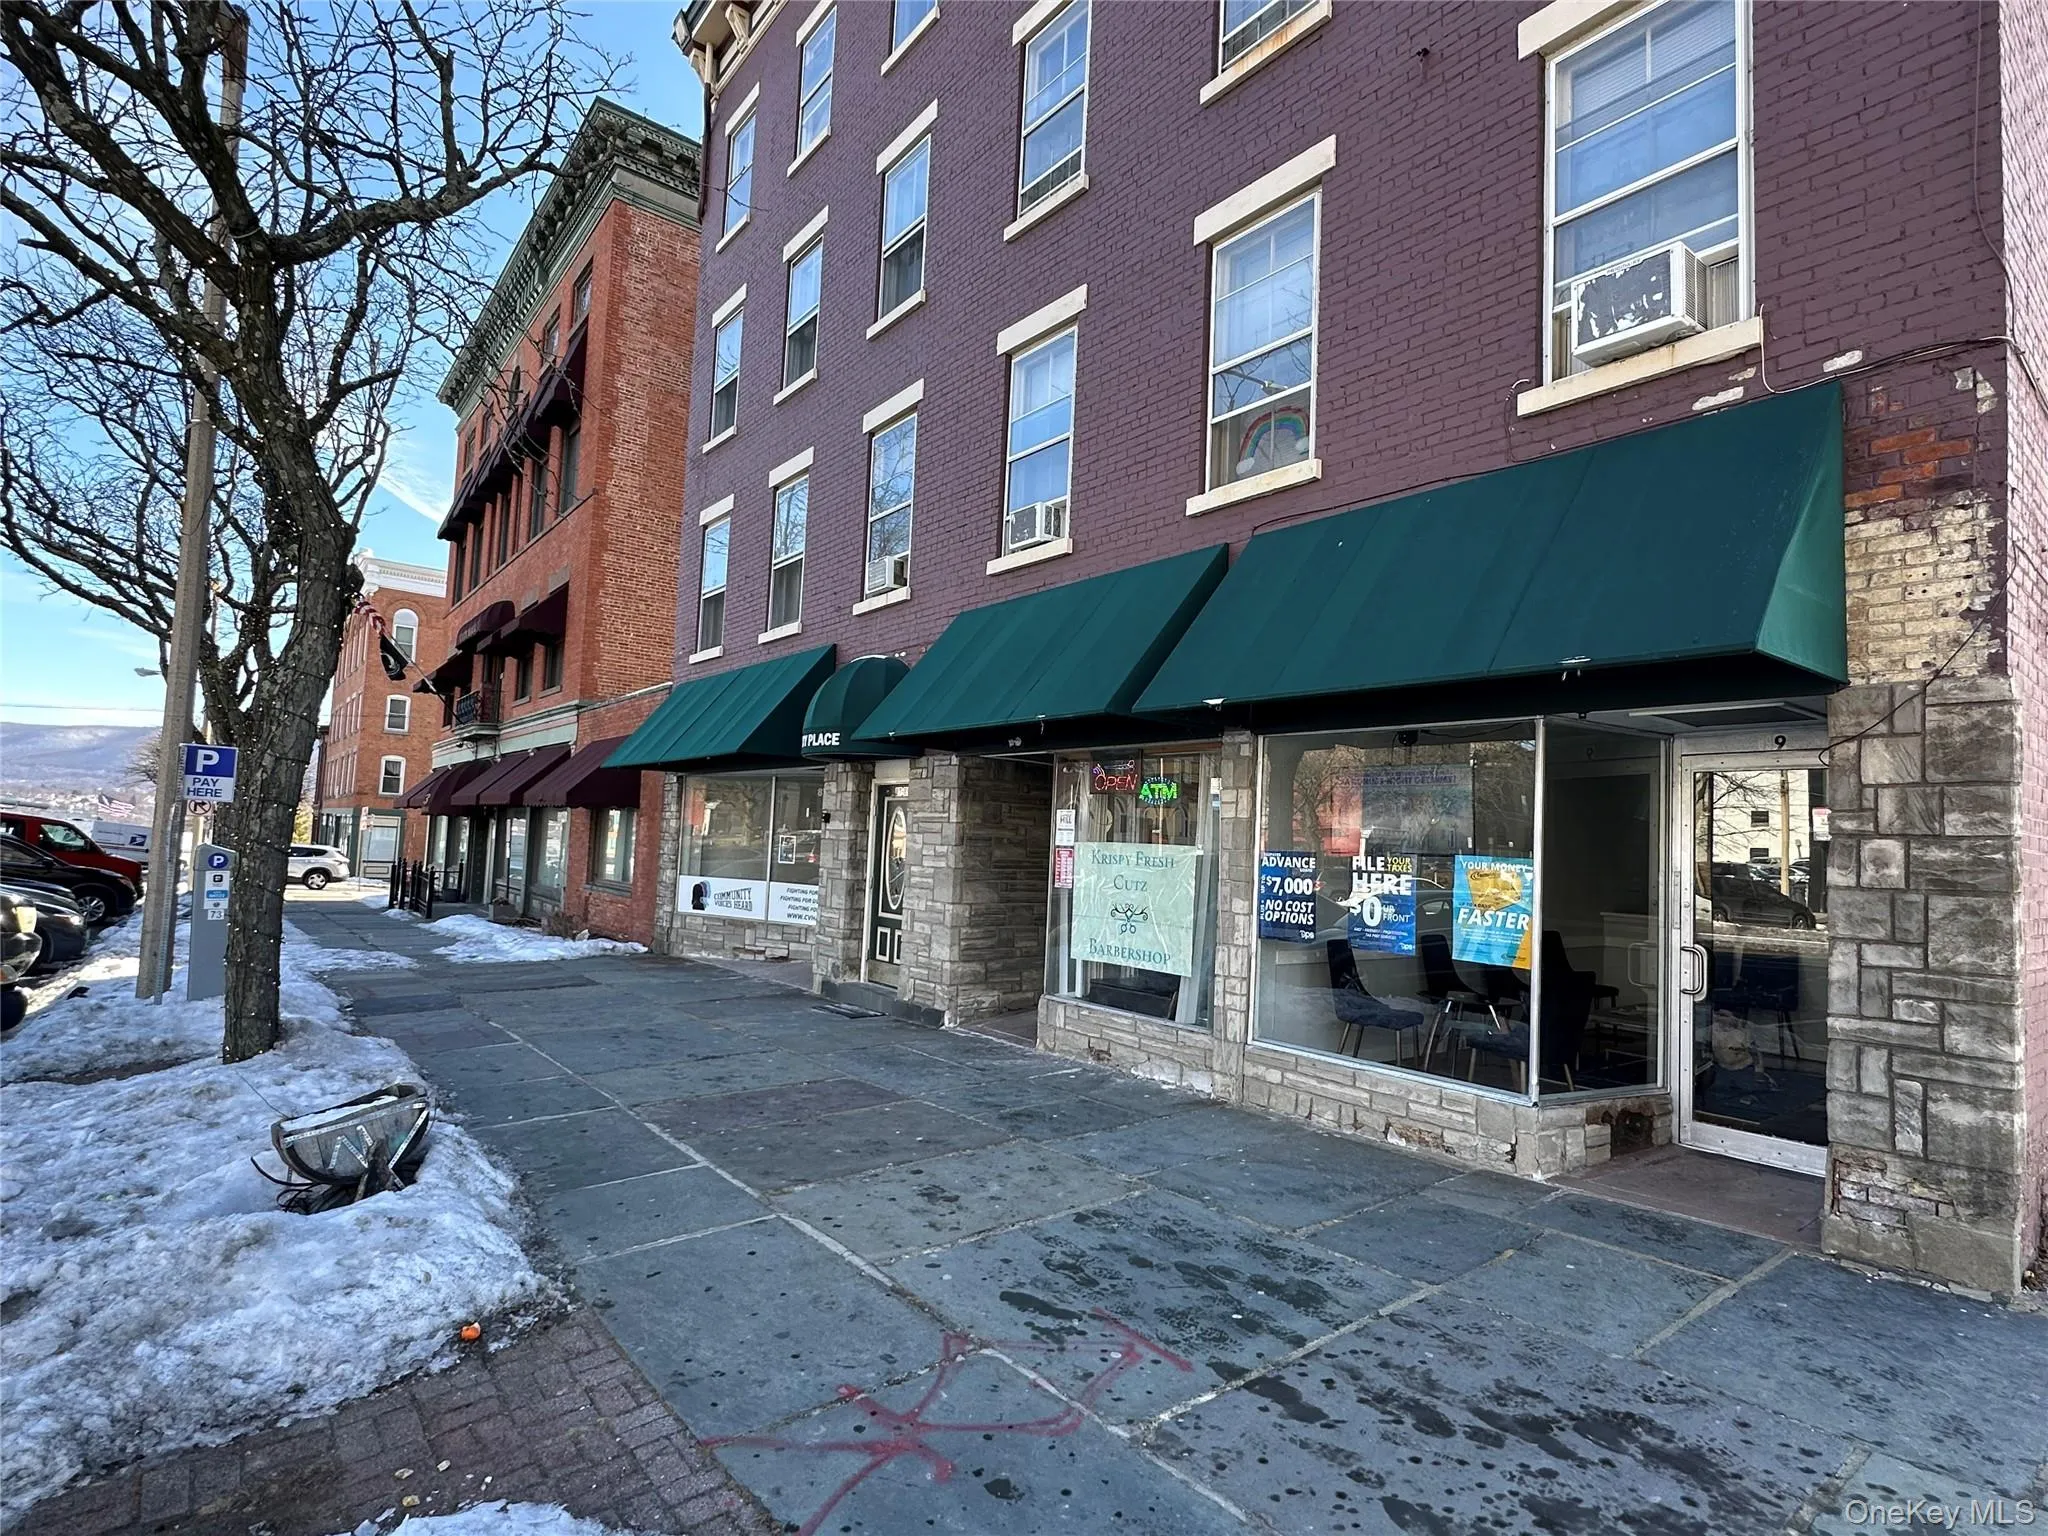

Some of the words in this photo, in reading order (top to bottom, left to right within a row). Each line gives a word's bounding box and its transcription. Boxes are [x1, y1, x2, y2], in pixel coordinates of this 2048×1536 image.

[807, 732, 840, 747] PLACE
[1774, 735, 1786, 749] 9
[195, 749, 220, 773] P
[192, 777, 219, 787] PAY
[1094, 774, 1138, 791] OPEN
[186, 787, 223, 797] HERE
[1139, 782, 1178, 800] ATM
[213, 855, 225, 867] P
[1091, 849, 1131, 867] KRISPY
[1135, 851, 1174, 869] FRESH
[1262, 856, 1316, 869] ADVANCE
[1352, 855, 1385, 871] FILE
[1387, 857, 1411, 865] YOUR
[1387, 865, 1413, 873] TAXES
[1461, 860, 1488, 870] YOUR
[1490, 862, 1528, 873] MONEY
[1113, 874, 1148, 892] CUTZ
[1266, 875, 1313, 897] $7,000
[1352, 872, 1413, 896] HERE
[714, 887, 753, 901] COMMUNITY
[780, 895, 802, 903] FIGHTING
[714, 900, 733, 909] VOICES
[733, 900, 753, 912] HEARD
[787, 904, 809, 912] FIGHTING
[1265, 899, 1283, 911] NO
[1285, 901, 1314, 914] COST
[210, 910, 222, 919] 73
[1264, 910, 1314, 926] OPTIONS
[1383, 913, 1411, 923] FRONT
[1457, 907, 1531, 931] FASTER
[1088, 938, 1171, 965] BARBERSHOP
